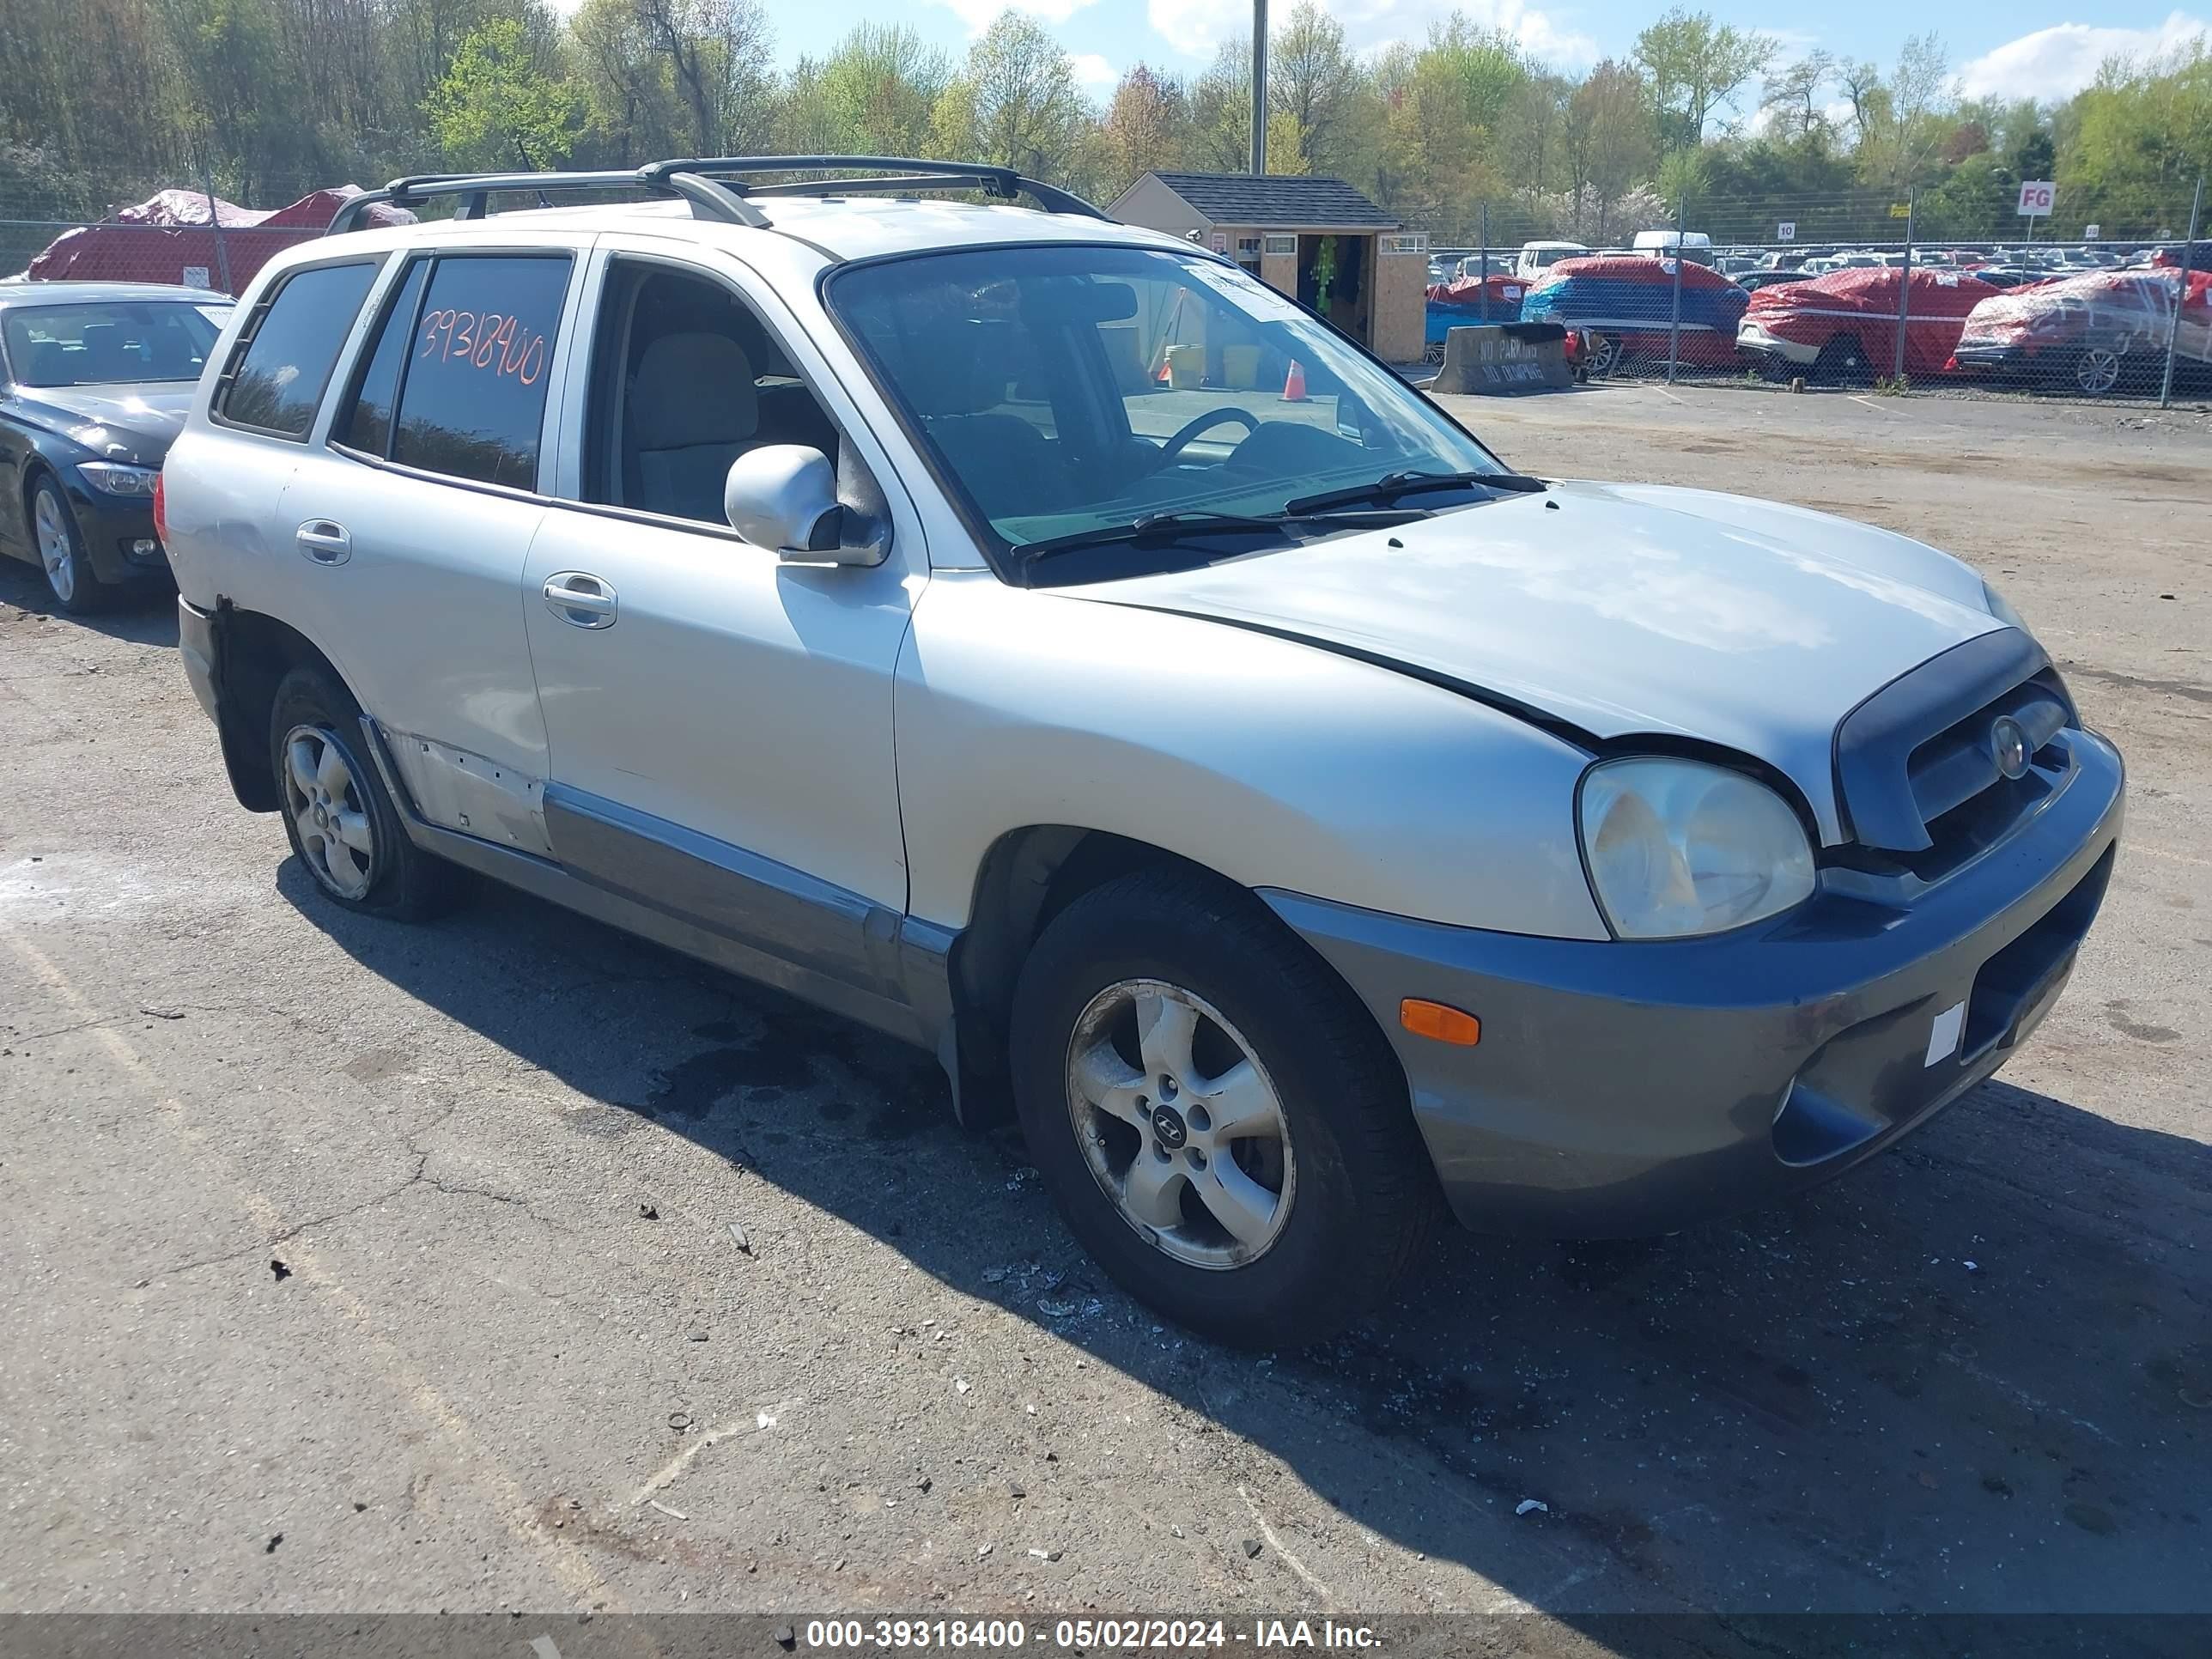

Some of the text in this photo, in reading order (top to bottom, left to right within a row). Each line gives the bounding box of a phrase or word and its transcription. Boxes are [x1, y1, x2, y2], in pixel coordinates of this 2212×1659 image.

[2023, 189, 2051, 207] FG
[1782, 226, 1792, 235] 10
[421, 309, 544, 385] 39318400
[1480, 340, 1493, 361] NO
